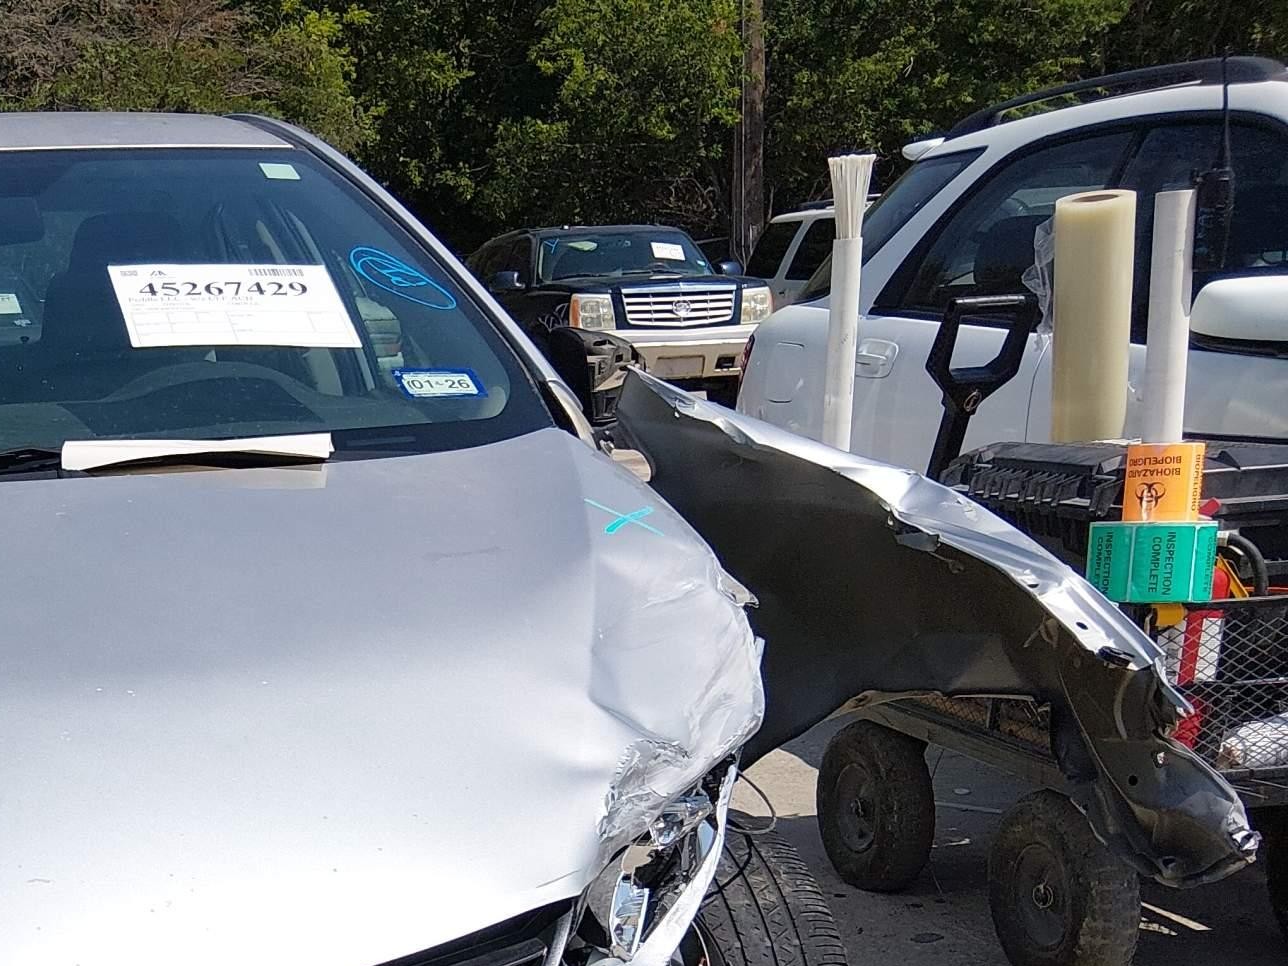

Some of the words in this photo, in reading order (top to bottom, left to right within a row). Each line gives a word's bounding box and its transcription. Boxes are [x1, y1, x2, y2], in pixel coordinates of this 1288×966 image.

[138, 281, 309, 297] 45267429
[1128, 467, 1181, 478] BIOHAZARD
[1129, 455, 1182, 466] BIOPELIGRO
[1094, 537, 1104, 586] COMPLET
[1102, 531, 1114, 597] INSPECTION
[1147, 536, 1162, 593] COMPLETE
[1161, 531, 1177, 596] INSPECTION
